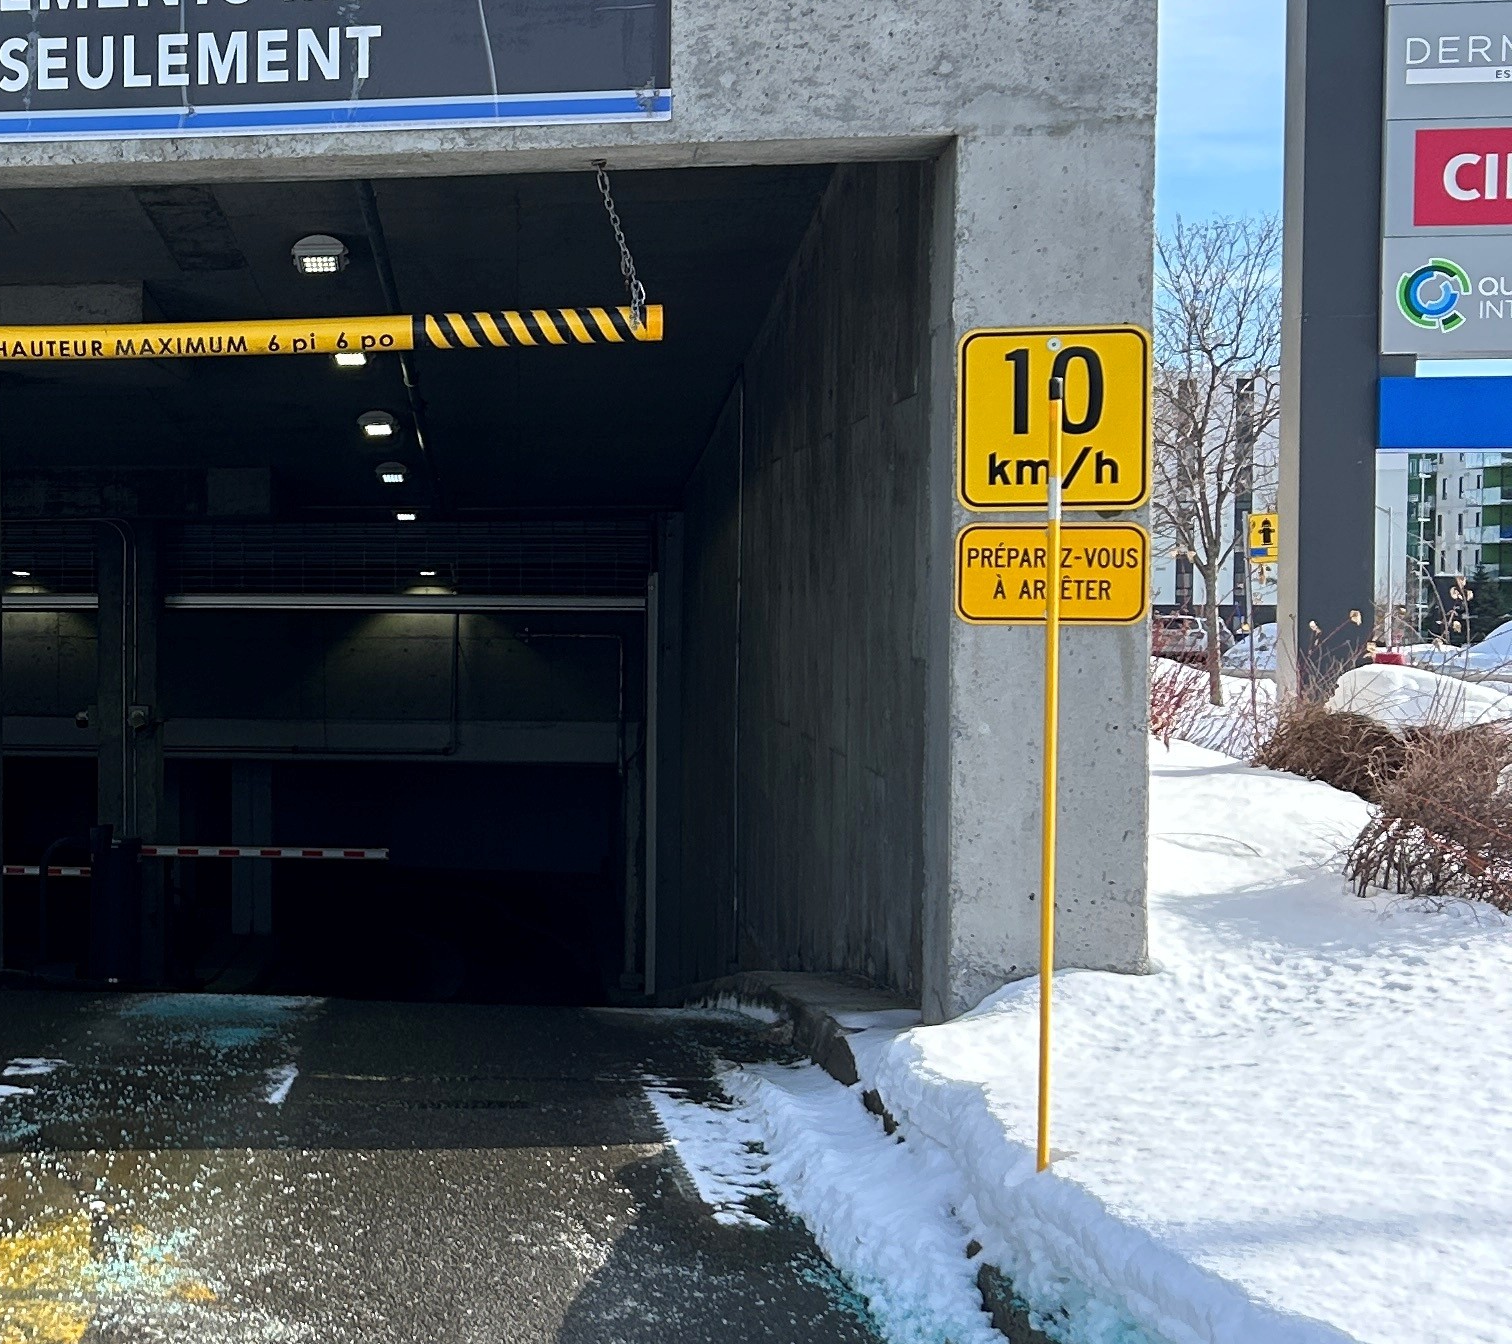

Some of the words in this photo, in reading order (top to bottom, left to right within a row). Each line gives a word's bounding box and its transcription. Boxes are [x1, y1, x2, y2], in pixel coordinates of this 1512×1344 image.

[1442, 152, 1512, 202] CI
[115, 336, 248, 356] MAXIMUM
[267, 334, 280, 352] 6
[292, 332, 316, 353] pi
[336, 331, 348, 350] 6
[361, 333, 394, 351] po
[1004, 345, 1105, 436] 10
[987, 445, 1119, 490] km/h
[966, 542, 1139, 569] PRÉPARZ-VOUS
[992, 573, 1007, 600] À
[1018, 575, 1112, 600] ARÊTER
